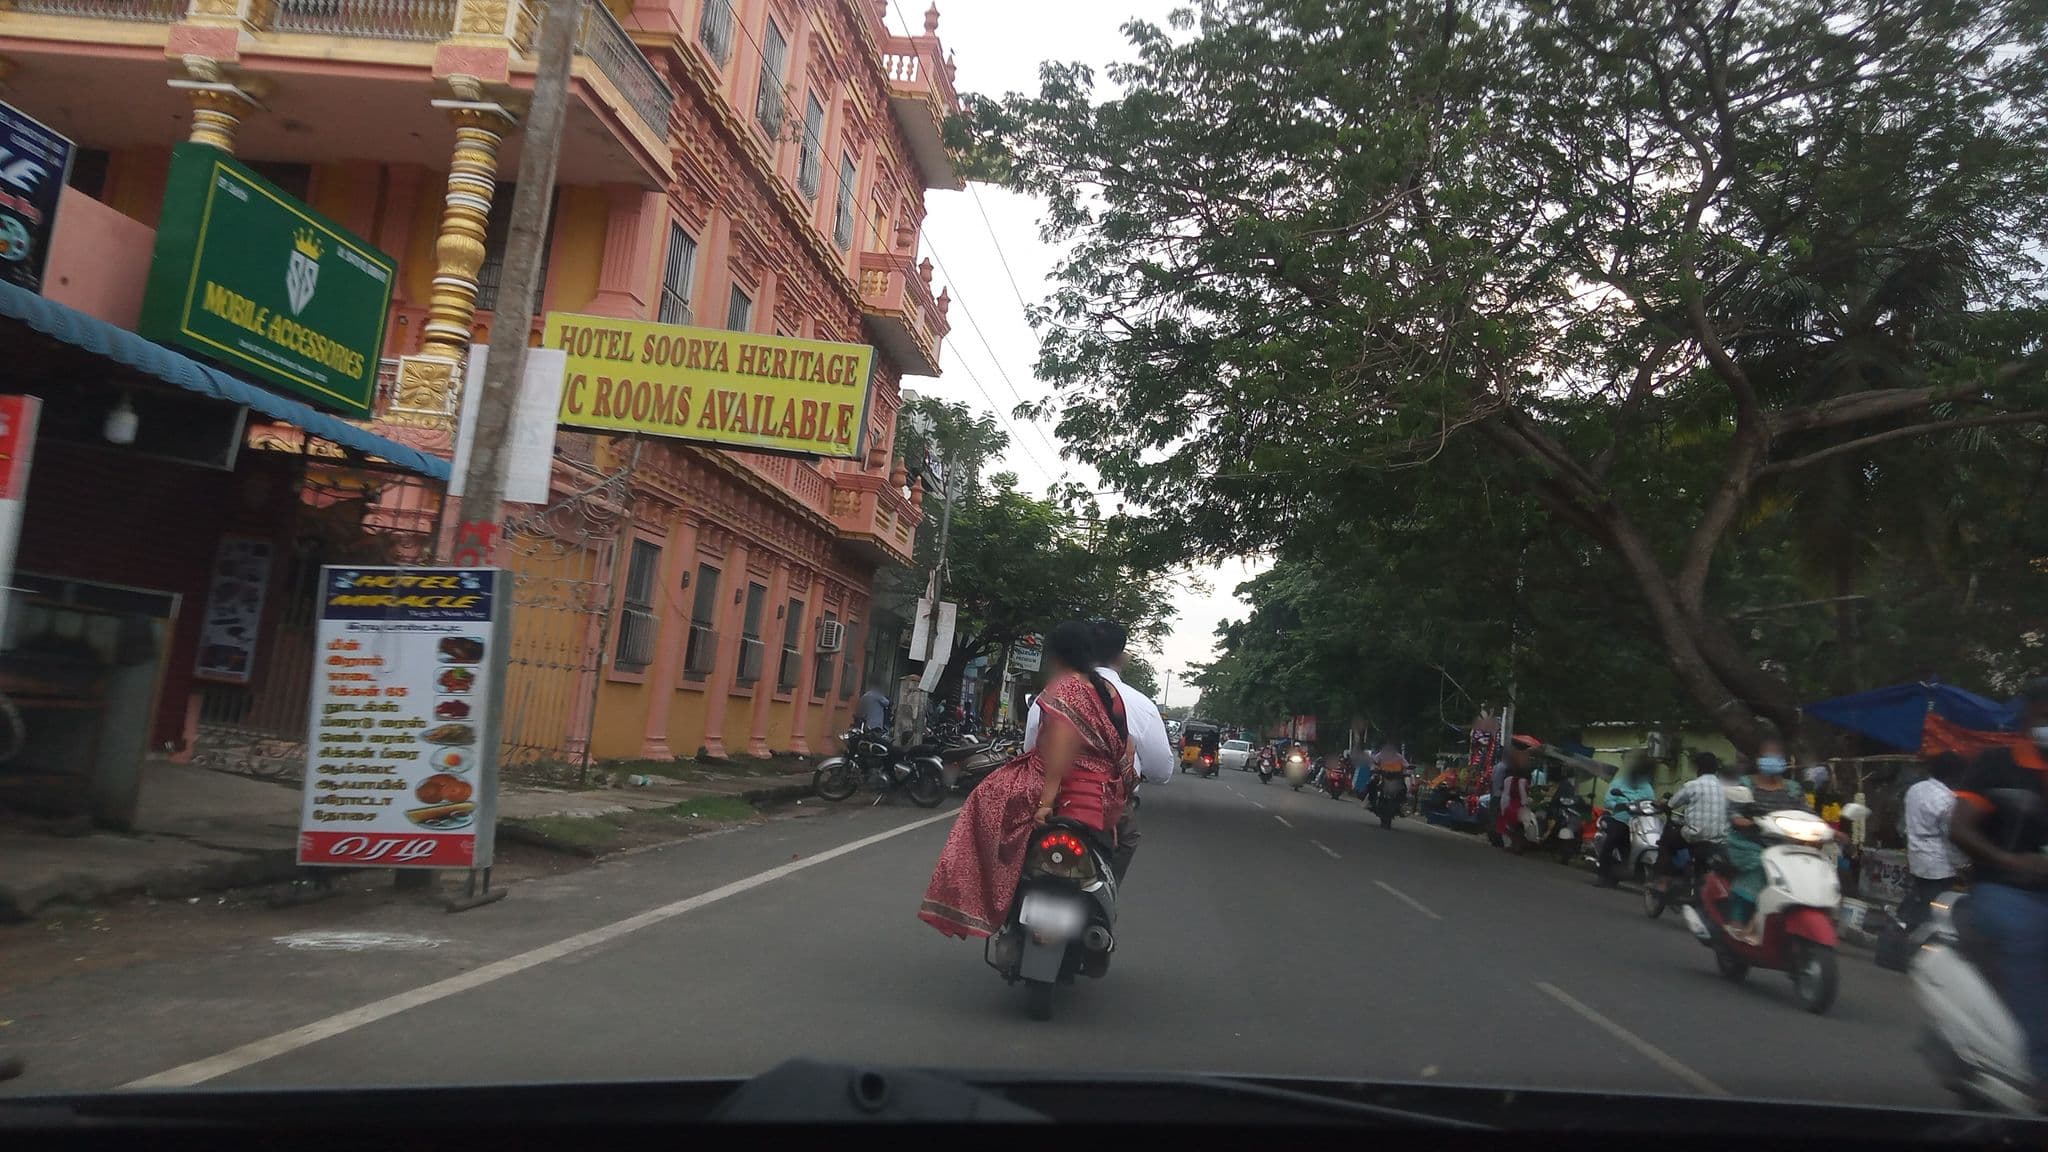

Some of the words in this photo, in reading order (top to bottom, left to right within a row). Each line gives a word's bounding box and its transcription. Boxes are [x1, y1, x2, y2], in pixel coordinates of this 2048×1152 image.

[202, 280, 270, 336] MOBILE
[268, 314, 365, 380] ACCESSORIES
[560, 325, 634, 361] HOTEL
[641, 334, 729, 373] SOORYA
[735, 344, 859, 387] HERITAGE
[558, 372, 587, 415] /C
[592, 376, 692, 426] ROOMS
[696, 388, 854, 444] AVAILABLE
[328, 594, 484, 608] MIRACLE
[353, 575, 460, 589] HOTEL
[384, 687, 409, 697] 65
